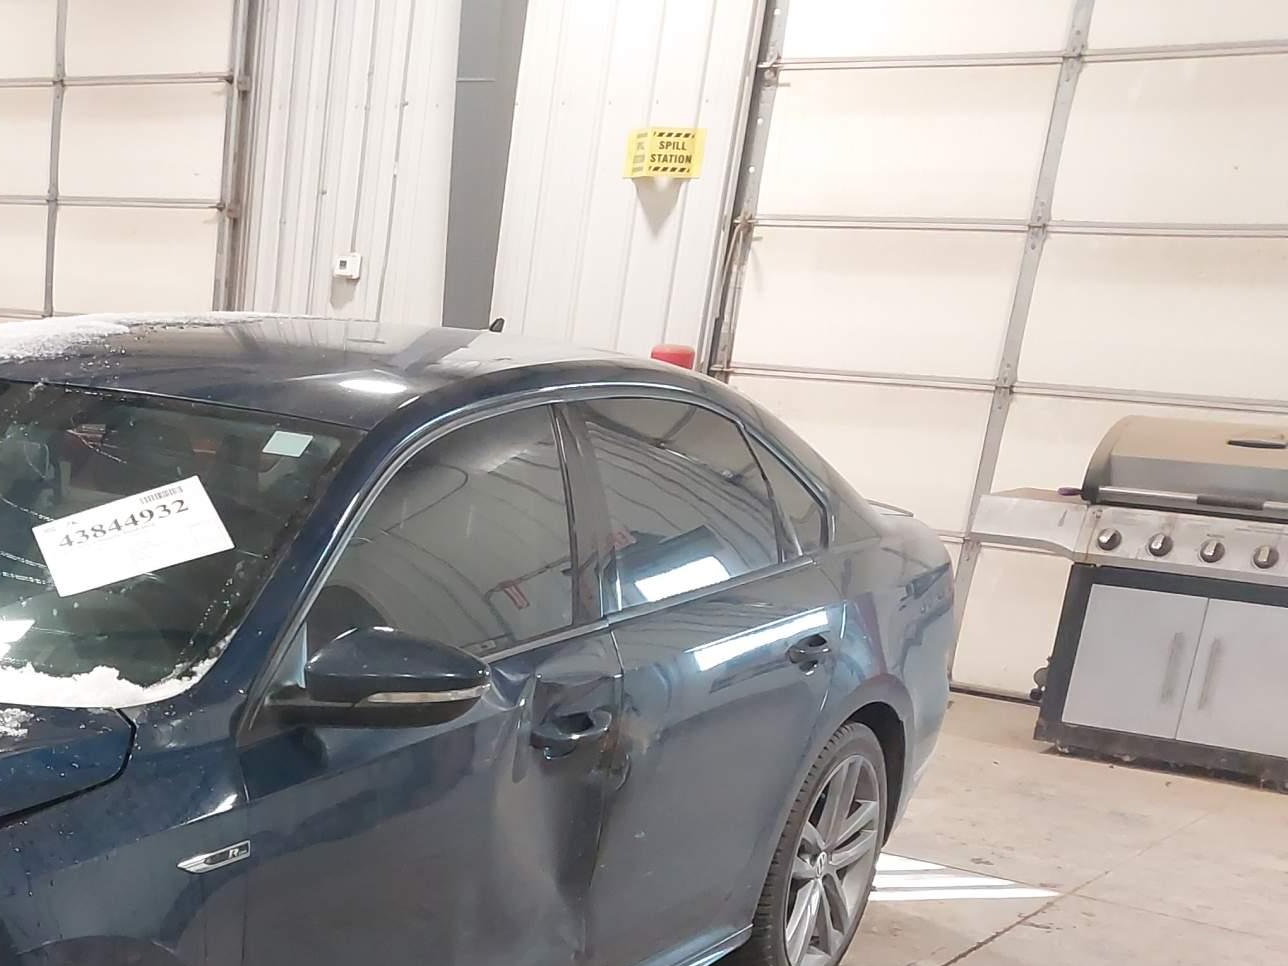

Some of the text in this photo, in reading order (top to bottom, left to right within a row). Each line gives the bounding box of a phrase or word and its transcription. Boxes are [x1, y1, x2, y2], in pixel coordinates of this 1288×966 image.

[658, 140, 687, 150] SPILL
[650, 153, 692, 164] STATION
[58, 499, 190, 548] 43844932
